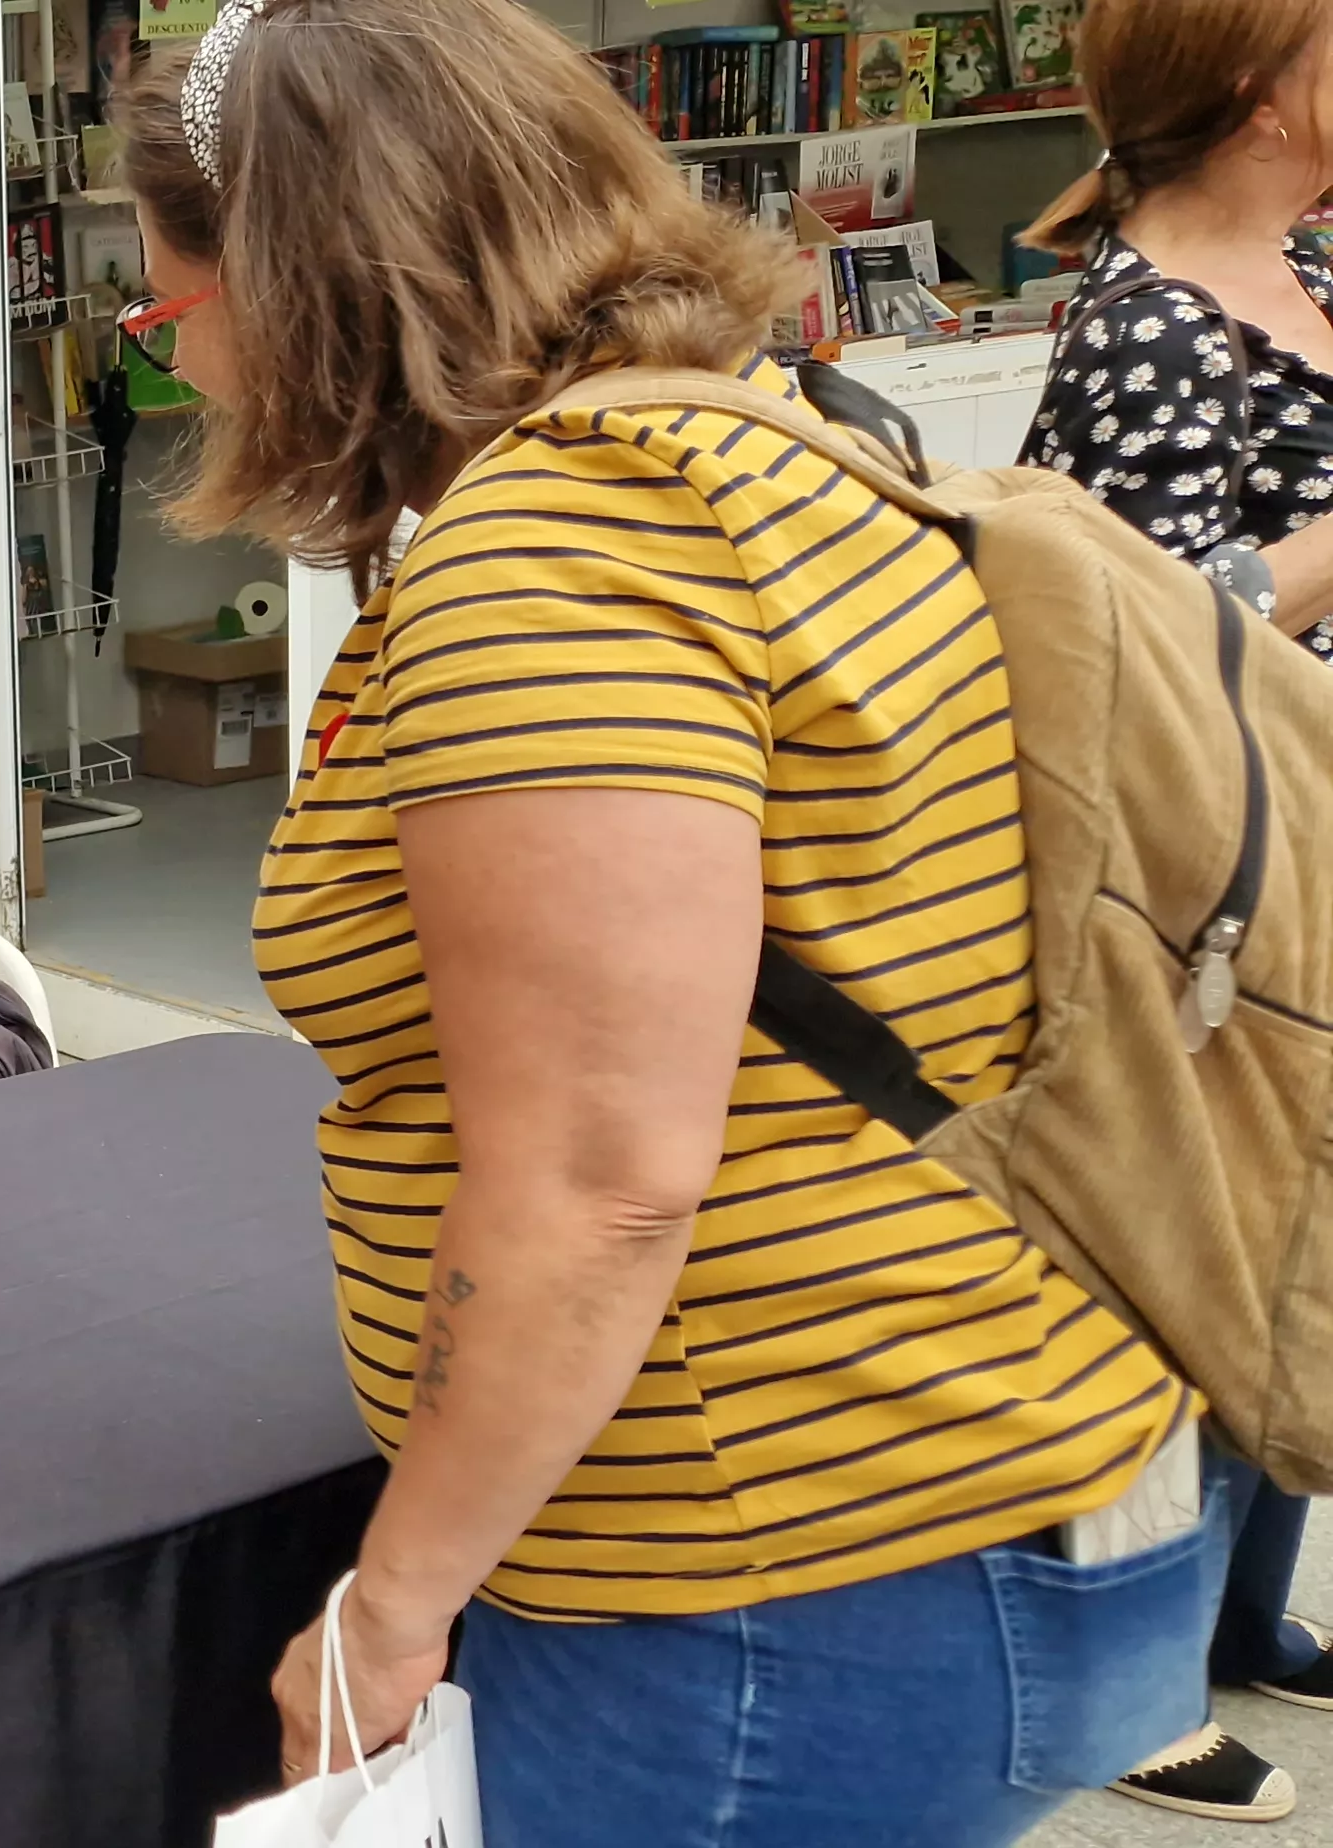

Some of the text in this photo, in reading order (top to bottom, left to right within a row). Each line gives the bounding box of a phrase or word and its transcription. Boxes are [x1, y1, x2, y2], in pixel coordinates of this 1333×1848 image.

[147, 23, 209, 34] DESCUENTO
[819, 140, 861, 166] JORGE
[815, 163, 864, 192] MOLIST
